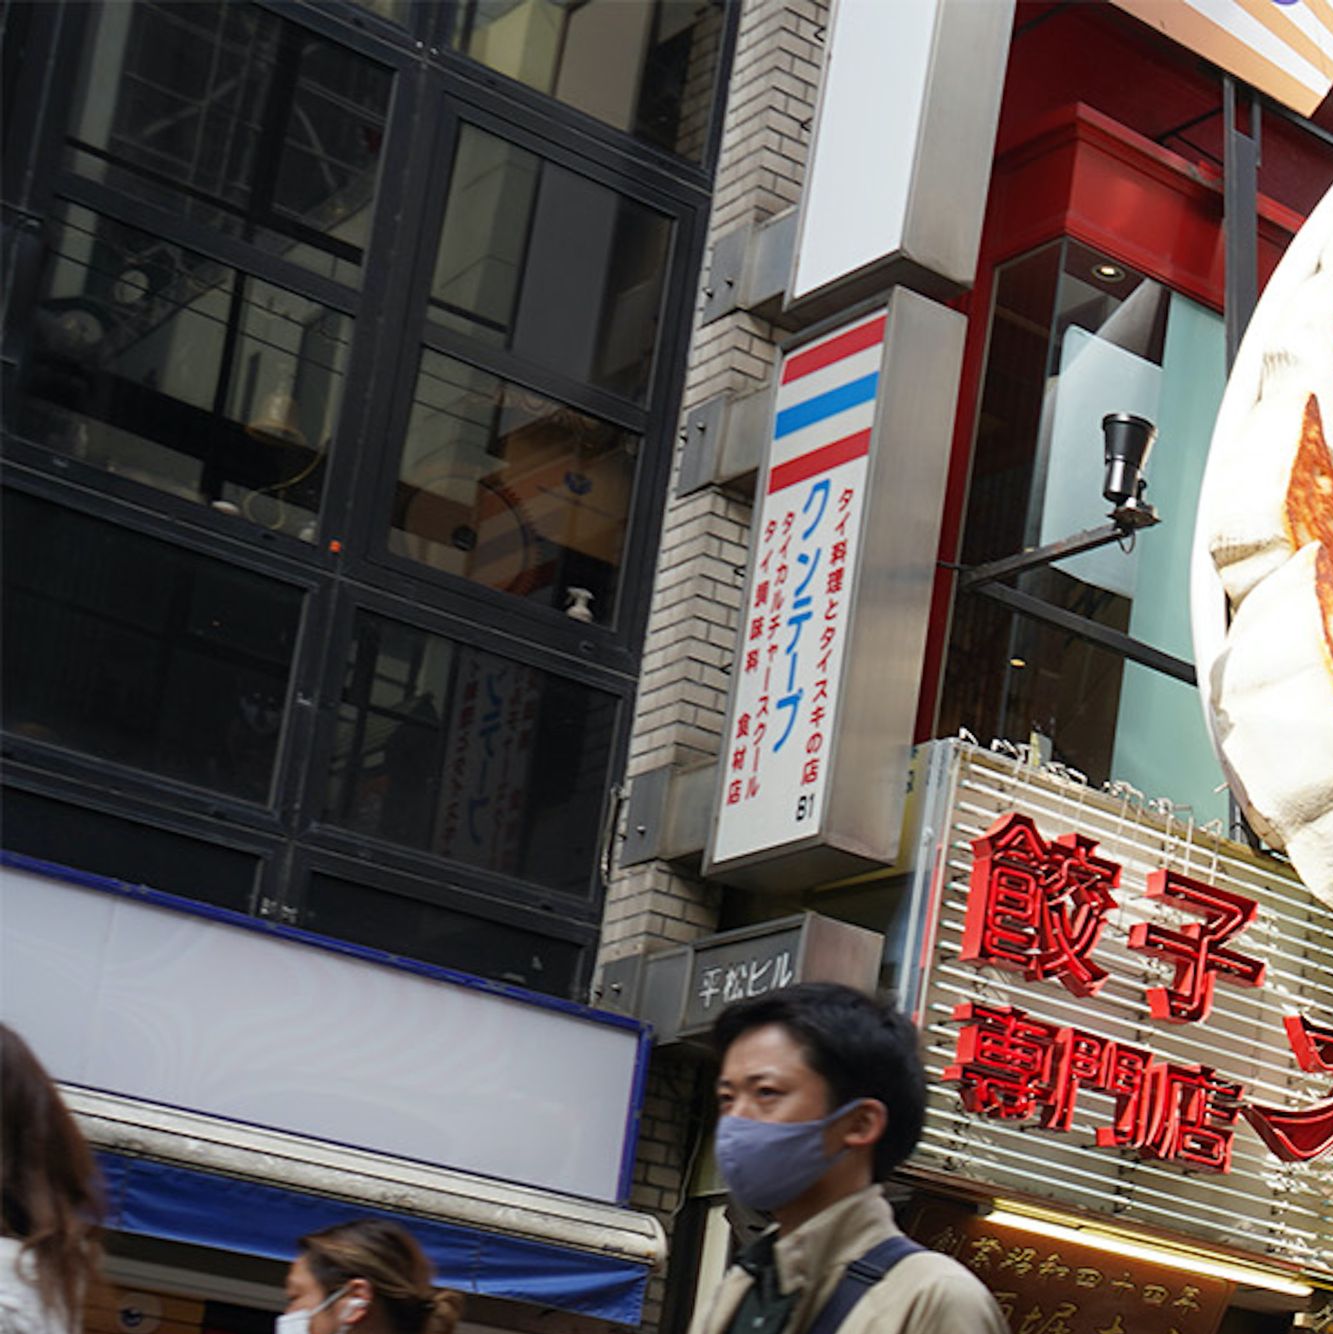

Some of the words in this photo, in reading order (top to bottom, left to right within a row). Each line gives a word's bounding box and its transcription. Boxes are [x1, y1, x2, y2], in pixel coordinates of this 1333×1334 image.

[773, 478, 831, 753] クンテープ
[796, 793, 815, 822] B1
[958, 811, 1267, 1025] 餃子
